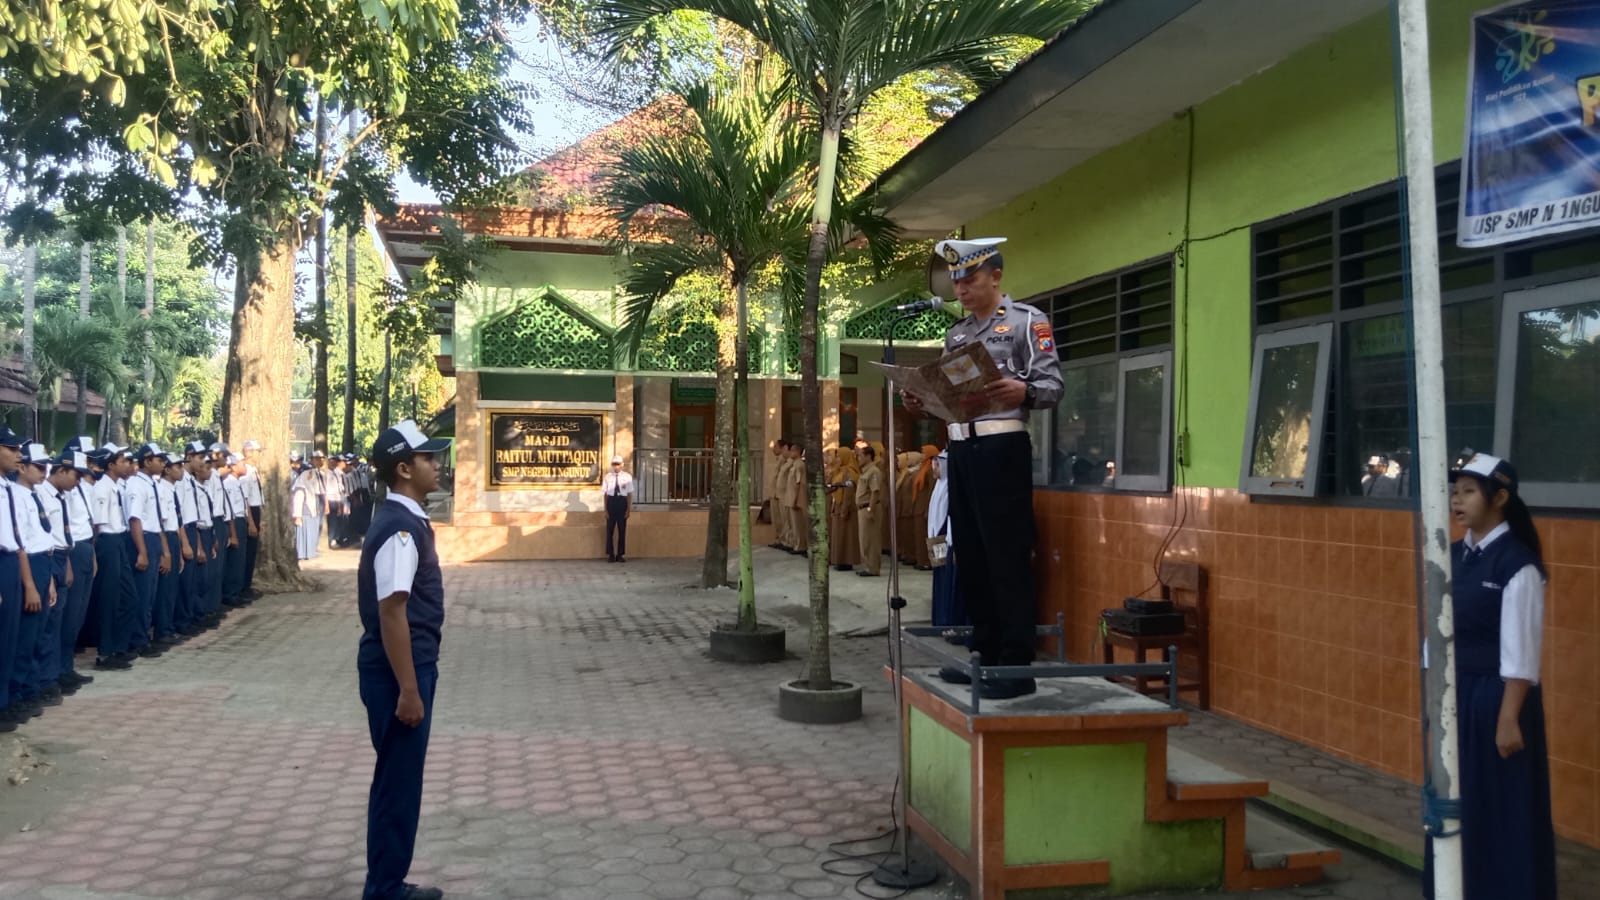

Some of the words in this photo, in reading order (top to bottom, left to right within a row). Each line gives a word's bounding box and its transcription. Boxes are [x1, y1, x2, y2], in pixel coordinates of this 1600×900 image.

[1472, 215, 1502, 235] USP
[1505, 207, 1539, 230] SMP
[1542, 203, 1555, 222] N
[986, 335, 1014, 343] POLRI
[524, 435, 570, 446] MASJID
[496, 449, 535, 463] BAITUL
[537, 450, 598, 467] MUTTAQIIN
[502, 466, 520, 478] SMP
[520, 466, 551, 478] NEGERI
[558, 467, 591, 478] NGUNUT
